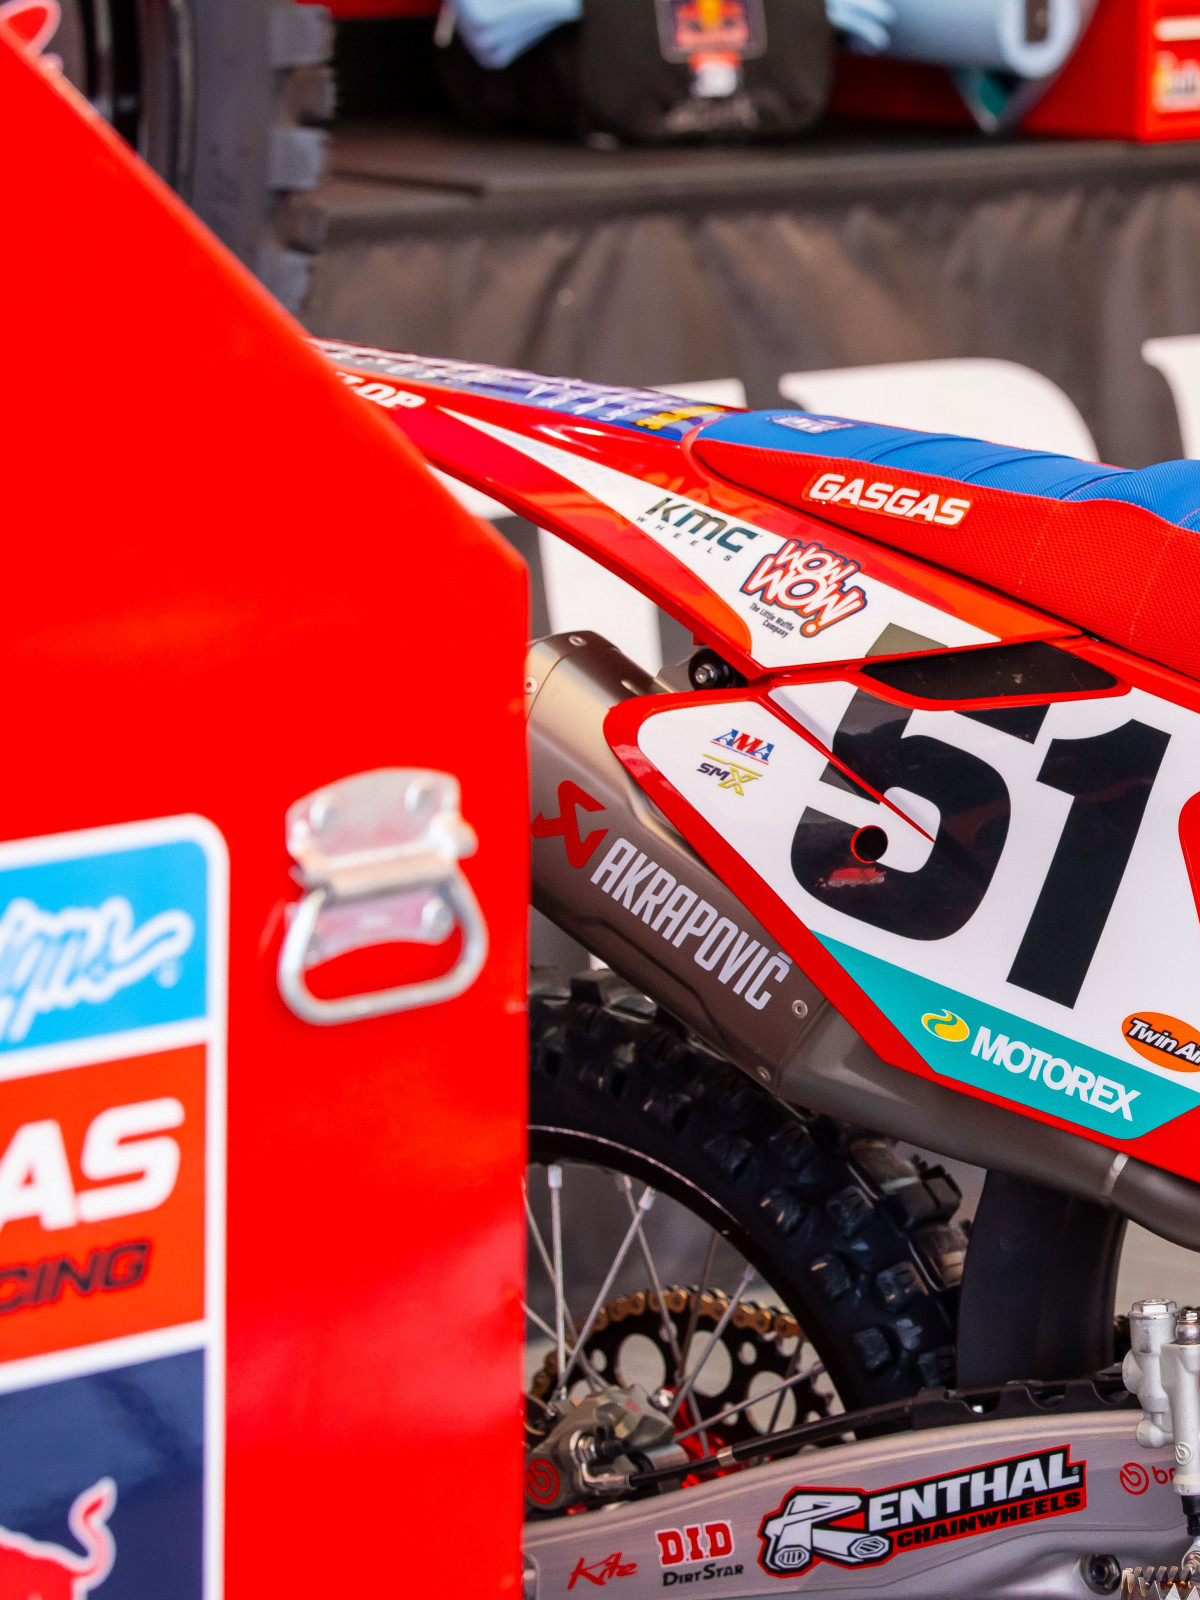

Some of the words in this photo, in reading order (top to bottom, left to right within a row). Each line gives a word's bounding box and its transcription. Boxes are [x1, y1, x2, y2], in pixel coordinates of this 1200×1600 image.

[809, 473, 971, 525] GASGAS
[637, 516, 732, 562] WHEELS
[712, 729, 775, 762] AMA
[696, 762, 759, 796] SMX
[790, 622, 1172, 1010] 51
[970, 1025, 1142, 1122] MOTOREX
[765, 1452, 1080, 1570] RENTHAL
[896, 1491, 1081, 1549] CHAINWHEELS
